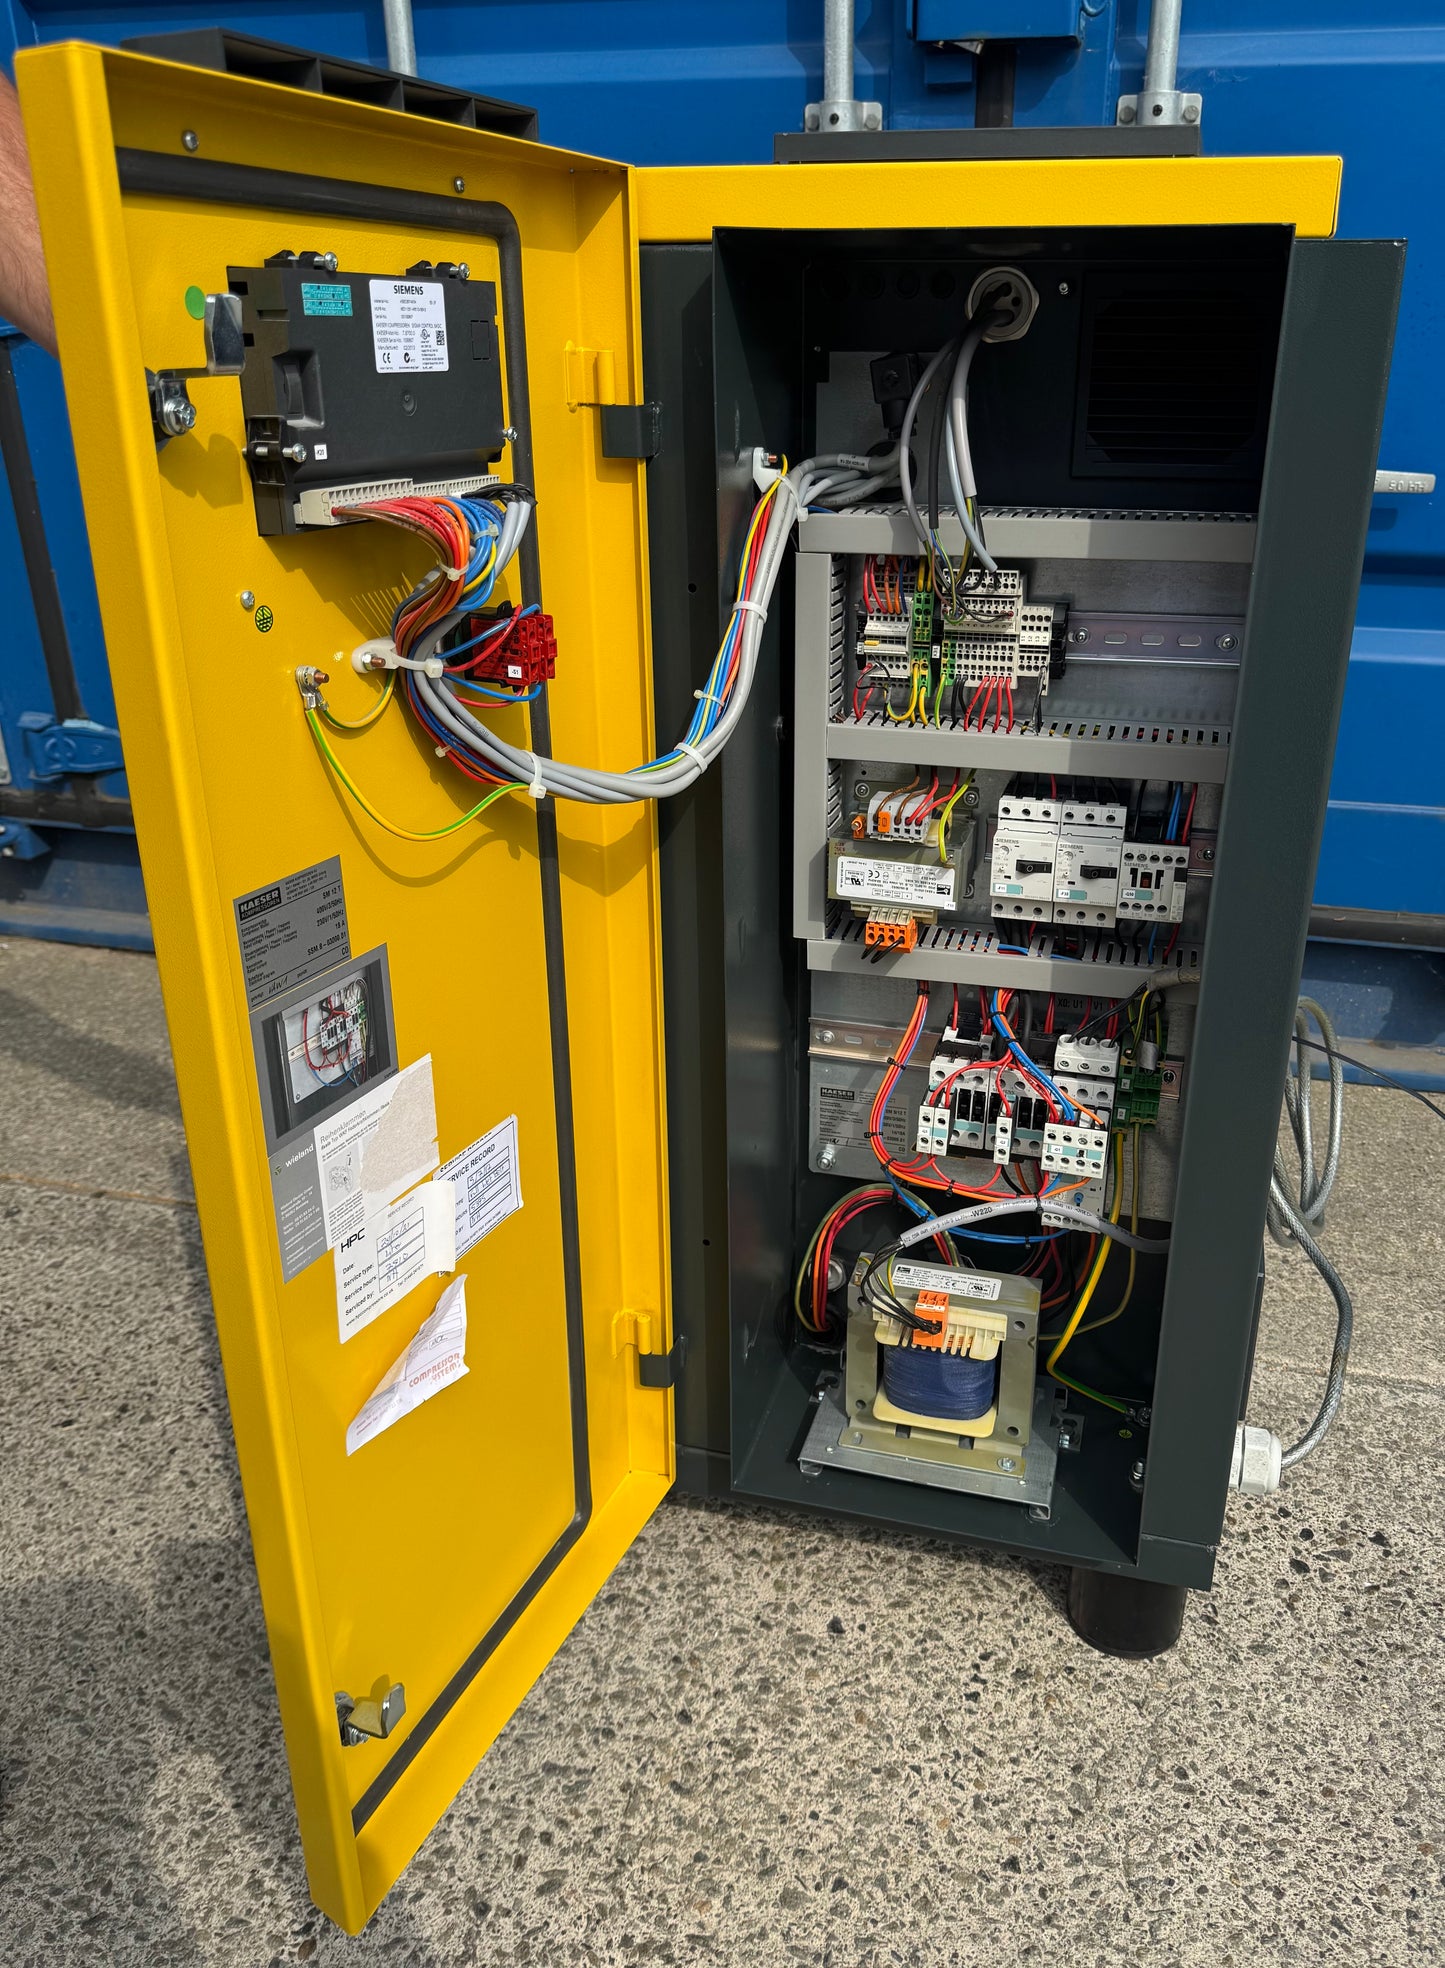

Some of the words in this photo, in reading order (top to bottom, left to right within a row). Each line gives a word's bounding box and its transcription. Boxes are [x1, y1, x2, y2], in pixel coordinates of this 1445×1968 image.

[394, 285, 423, 295] SIEMENS
[240, 890, 279, 912] KAESER
[242, 898, 280, 919] KOMPRESSOREN
[822, 1088, 853, 1097] KAESER
[285, 1144, 314, 1168] wieland
[447, 1163, 469, 1182] RVICE
[470, 1144, 495, 1168] RECORD
[970, 1207, 992, 1218] -W220
[340, 1227, 365, 1253] HPC
[343, 1272, 361, 1288] Service
[362, 1264, 374, 1276] type:
[344, 1285, 362, 1302] Service
[345, 1297, 366, 1316] Serviced
[408, 1352, 460, 1388] COMPRESSOR
